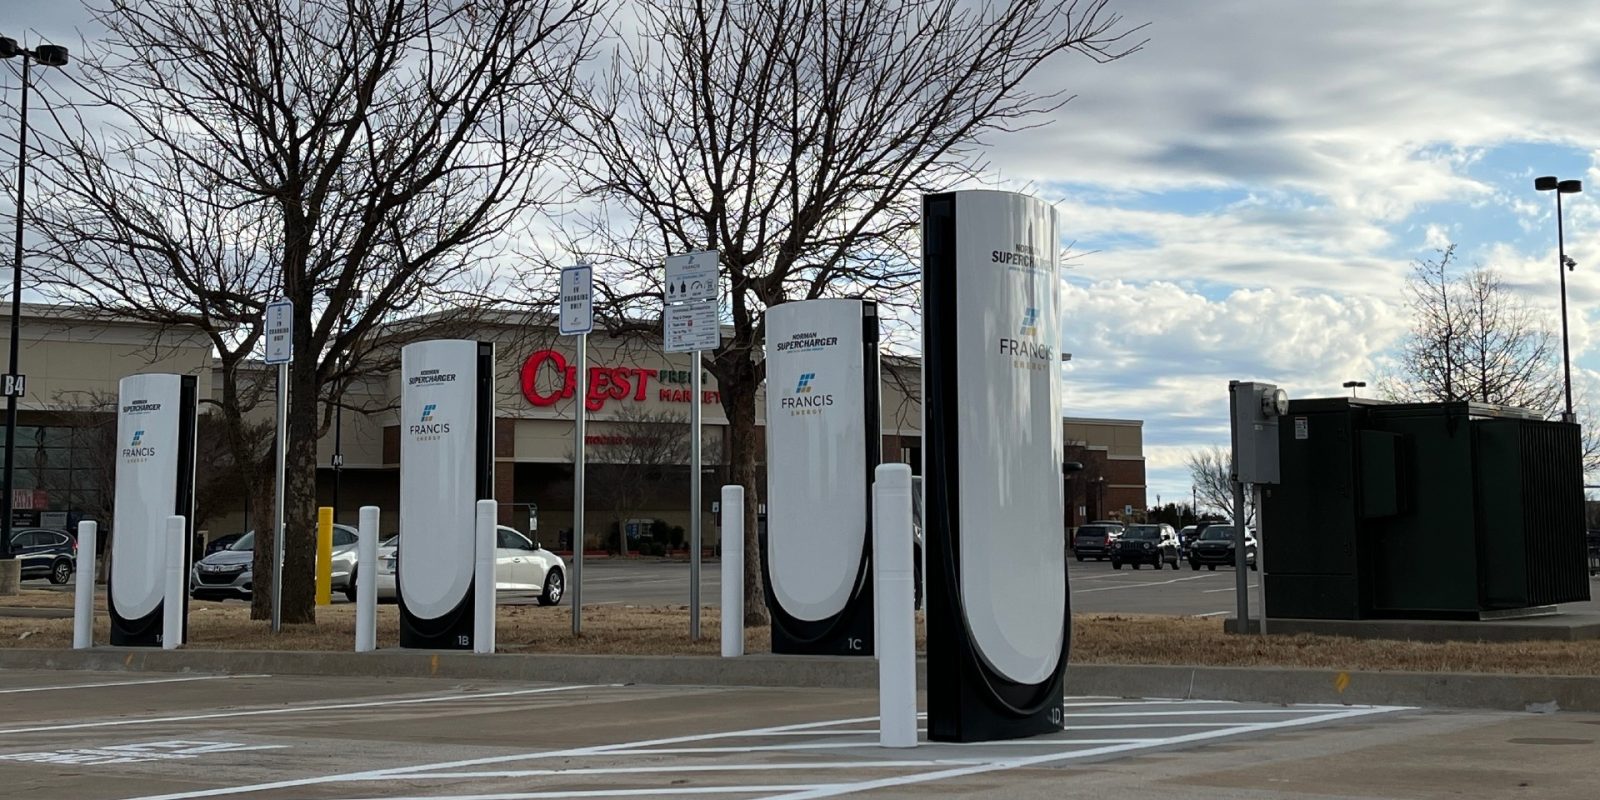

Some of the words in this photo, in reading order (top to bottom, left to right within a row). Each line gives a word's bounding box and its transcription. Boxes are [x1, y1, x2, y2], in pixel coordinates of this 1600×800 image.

[792, 331, 817, 340] NORMAN
[777, 337, 838, 352] SUPERCHARGER
[1000, 338, 1054, 361] FRANCIS
[4, 375, 24, 396] B4
[409, 374, 457, 385] SUPERCHARGER
[781, 394, 834, 409] FRANCIS
[410, 423, 450, 435] FRANCIS
[122, 447, 155, 458] FRANCIS
[458, 635, 470, 646] 1B
[848, 638, 862, 650] 1C
[1051, 707, 1061, 725] 1D
